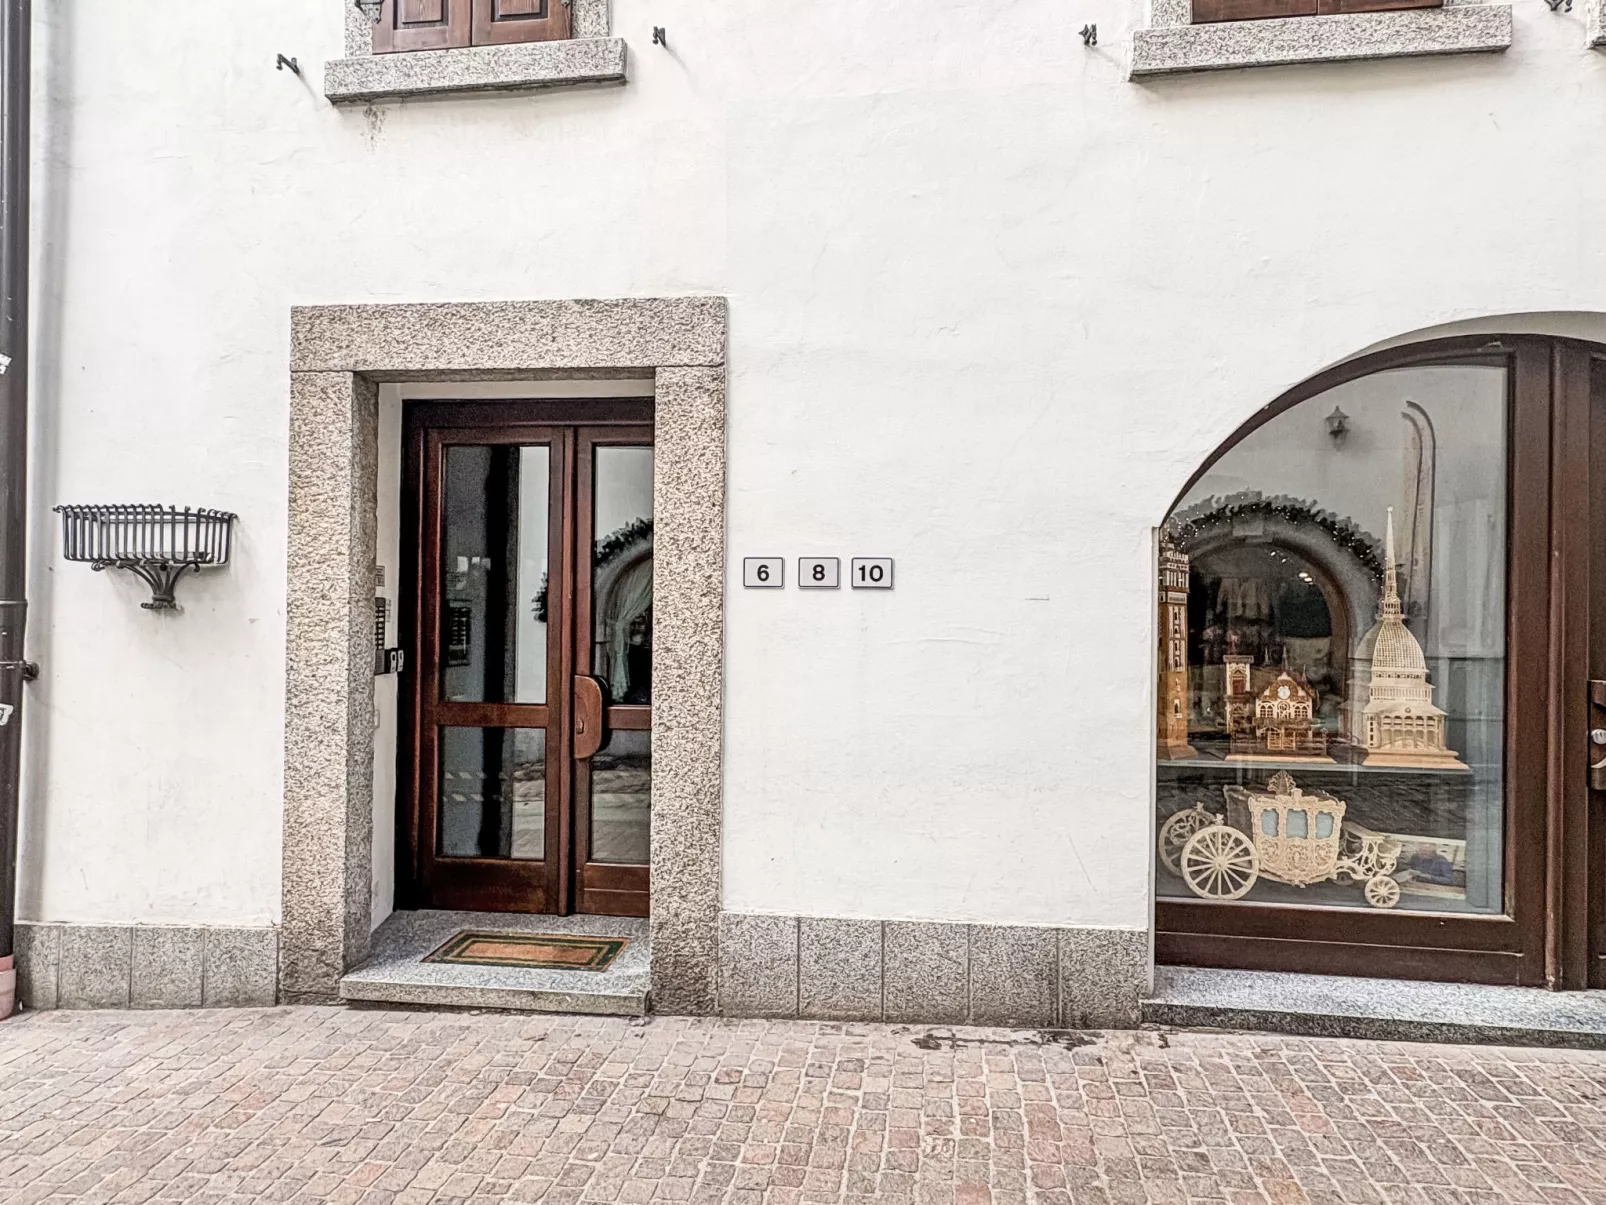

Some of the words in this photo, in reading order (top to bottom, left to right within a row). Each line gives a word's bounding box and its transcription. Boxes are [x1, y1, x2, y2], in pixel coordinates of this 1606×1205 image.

[757, 564, 770, 582] 6
[812, 564, 825, 581] 8
[858, 564, 884, 582] 10
